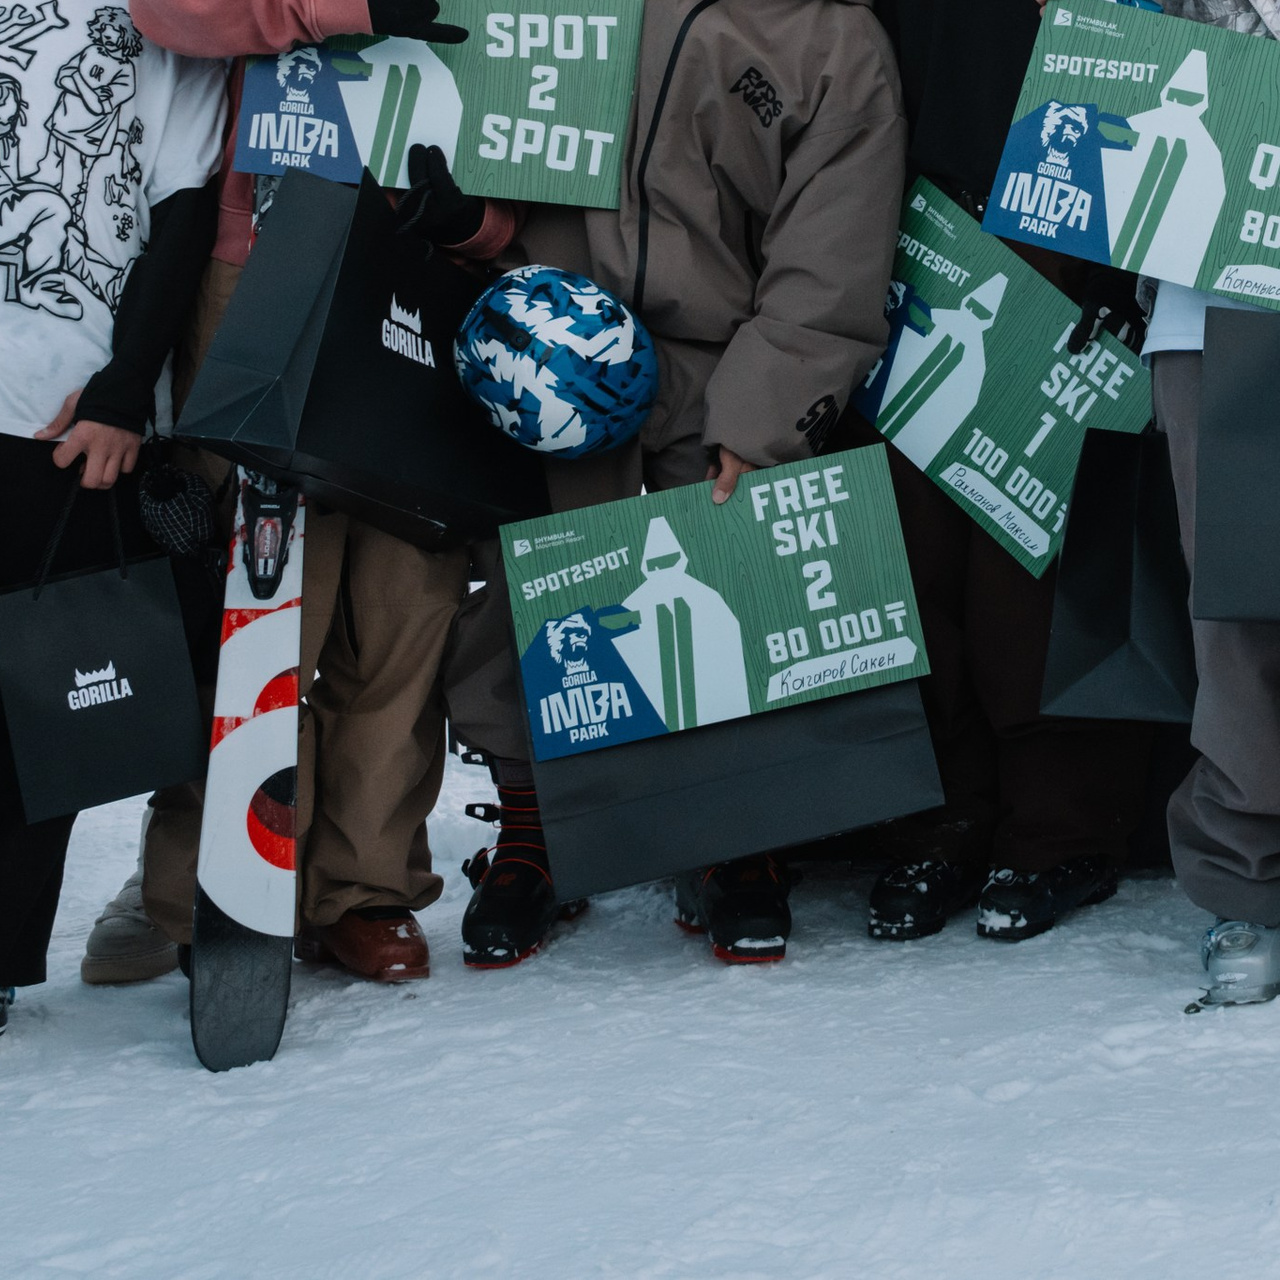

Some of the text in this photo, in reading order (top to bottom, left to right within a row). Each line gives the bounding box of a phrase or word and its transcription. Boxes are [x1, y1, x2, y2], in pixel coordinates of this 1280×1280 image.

[485, 13, 617, 61] SPOT
[1075, 22, 1125, 39] Mountain Resort
[1076, 15, 1118, 30] SHYMBULAK
[528, 65, 559, 111] 2
[1043, 53, 1159, 83] SPOT2SPOT
[279, 101, 315, 115] GORILLA
[248, 113, 339, 158] IMBA
[479, 113, 614, 176] SPOT
[272, 150, 311, 168] PARK
[1037, 162, 1072, 181] GORILLA
[999, 171, 1093, 231] IMBA
[1019, 215, 1059, 239] PARK
[897, 230, 971, 287] POT2SPOT
[381, 319, 436, 369] GORILLA
[1040, 362, 1099, 424] SKI
[962, 427, 1009, 478] 100
[1024, 412, 1058, 458] 1
[750, 465, 850, 521] FREE
[534, 530, 575, 544] SHYMBULAK
[771, 510, 839, 557] SKI
[522, 546, 630, 601] SPOT2SPOT
[802, 560, 836, 611] 2
[765, 626, 810, 664] 80
[850, 653, 896, 675] Сакен
[67, 678, 133, 711] GORILLA
[561, 671, 598, 689] GORILLA
[539, 682, 633, 734] IMBA
[569, 722, 609, 743] PARK
